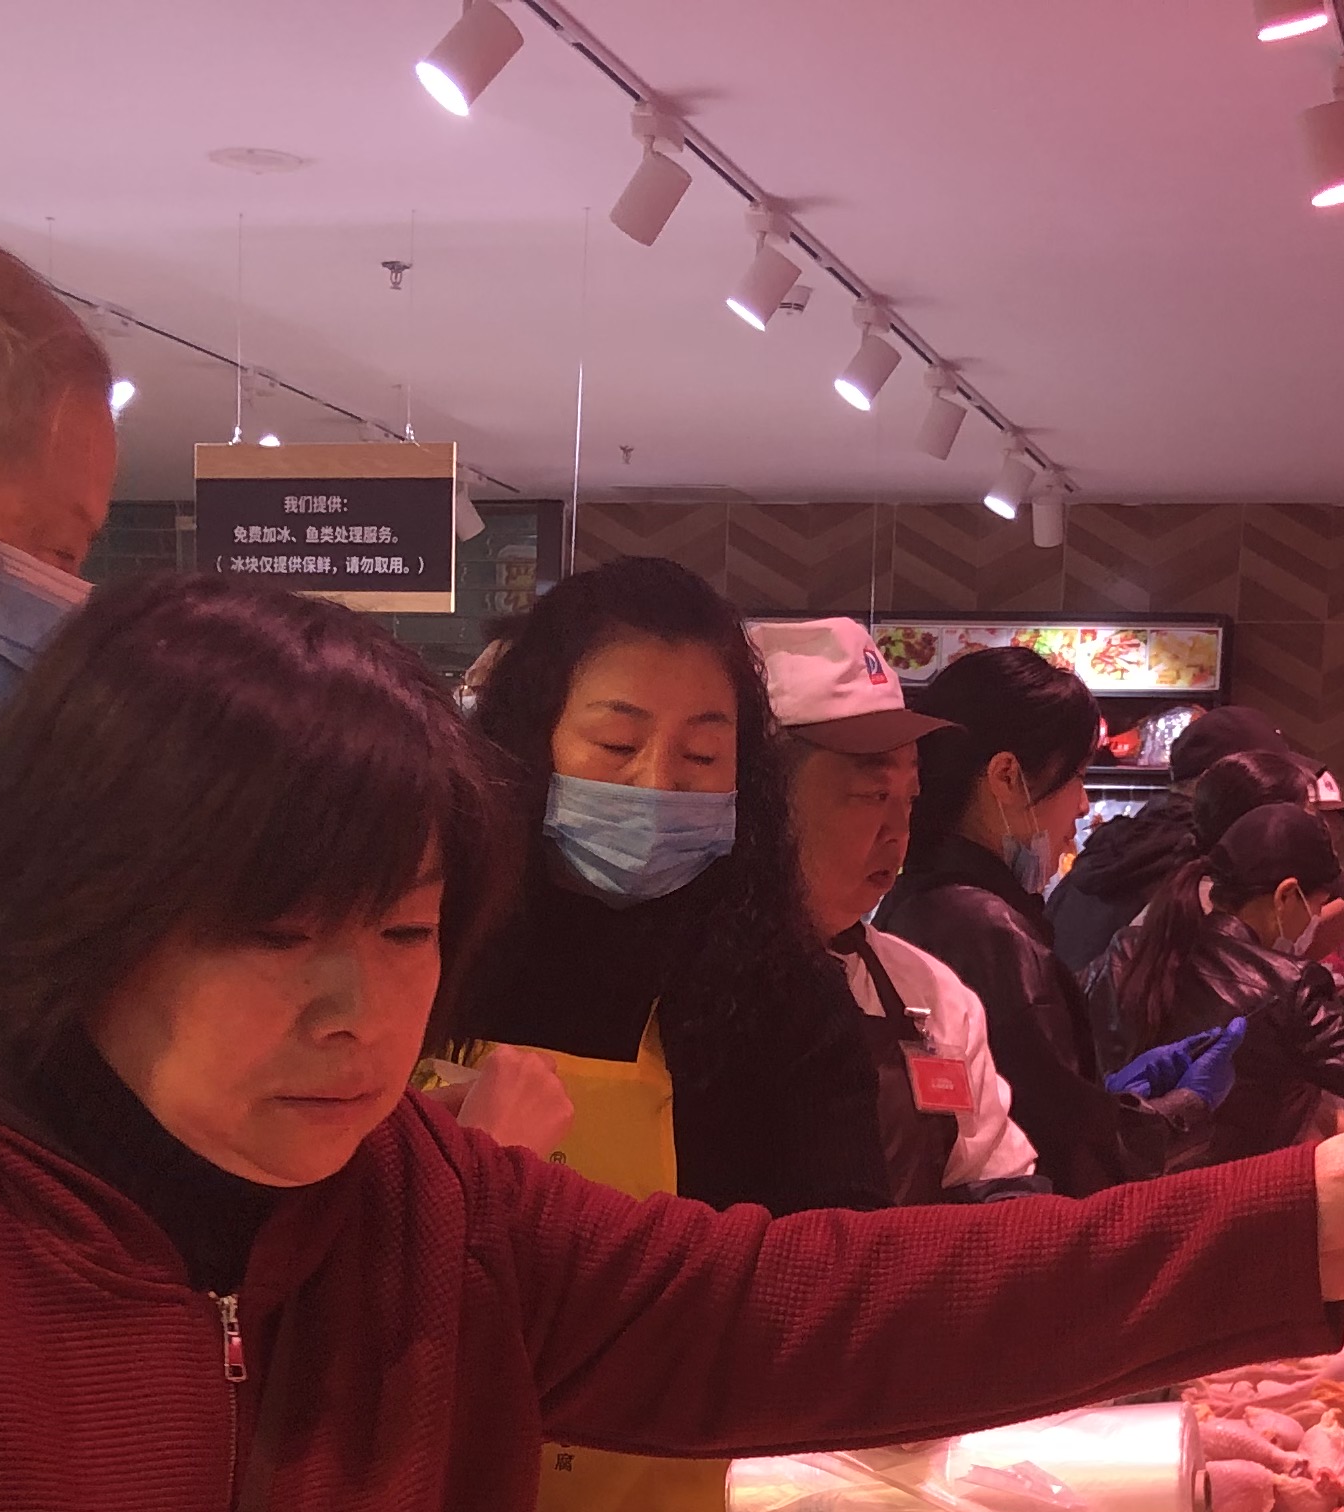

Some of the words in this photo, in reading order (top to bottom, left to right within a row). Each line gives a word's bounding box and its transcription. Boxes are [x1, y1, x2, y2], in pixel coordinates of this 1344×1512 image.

[284, 496, 348, 513] 我们提供：
[233, 526, 399, 543] 免费加冰、鱼类处理服务。
